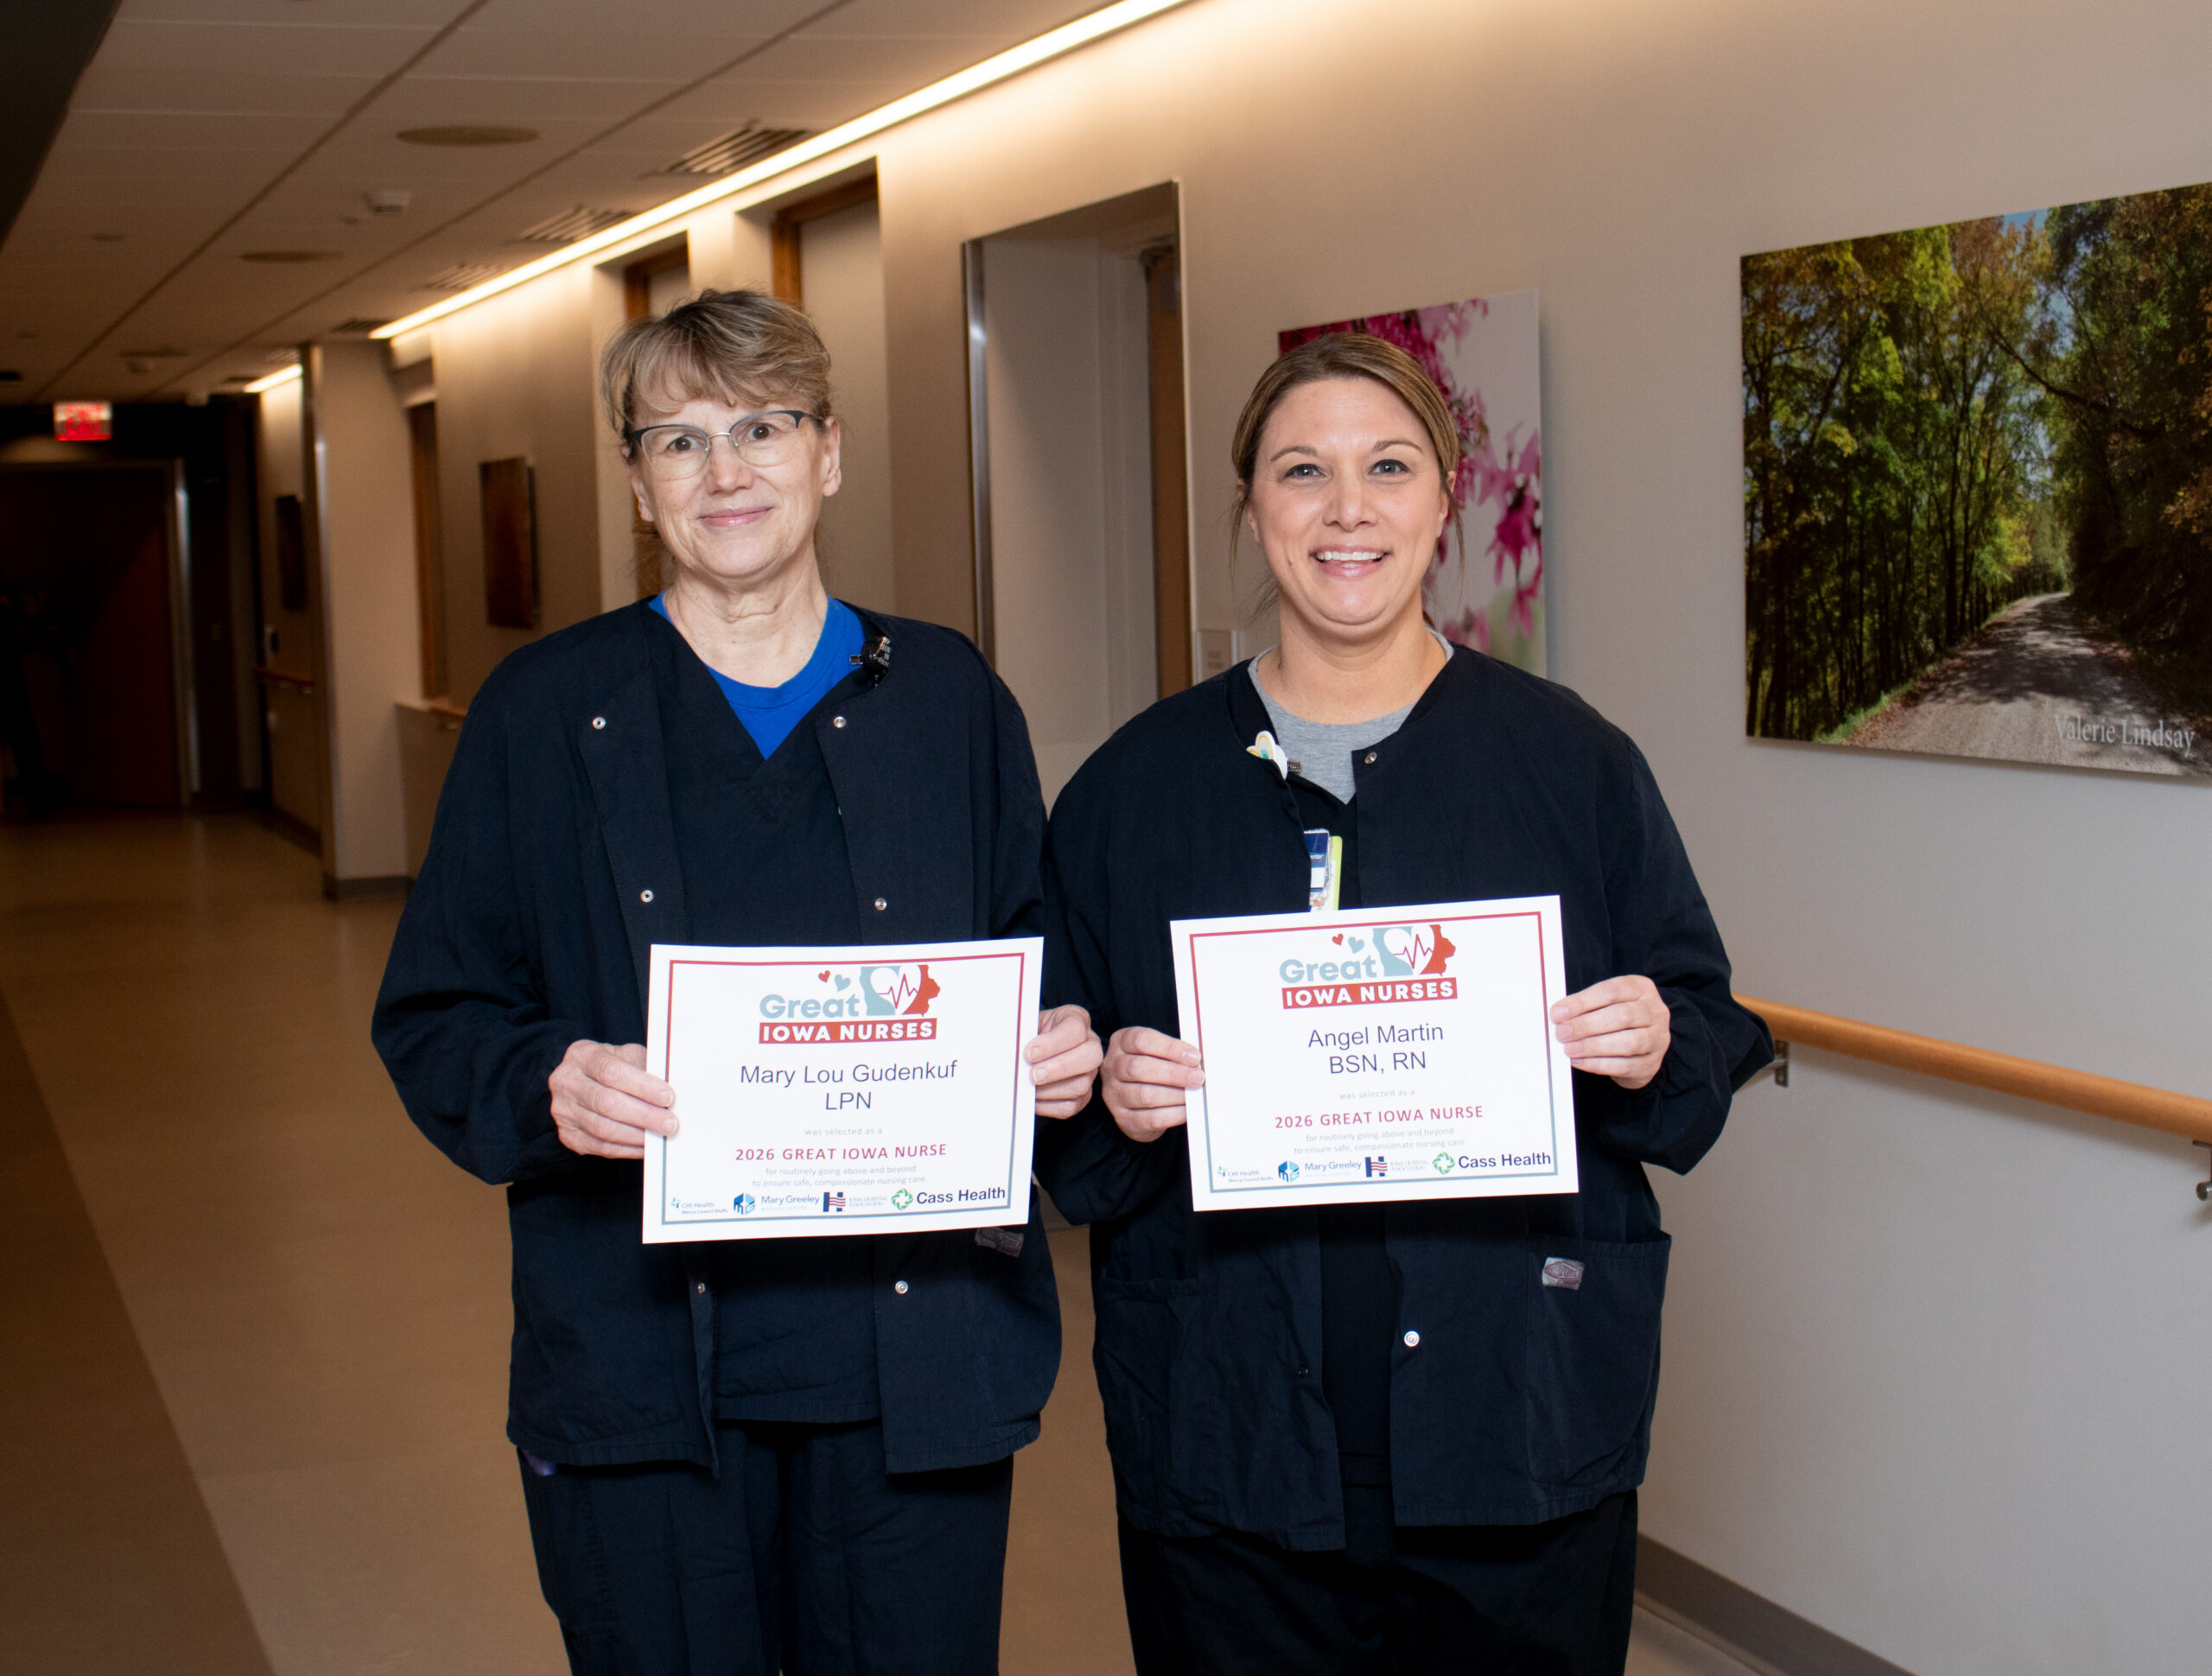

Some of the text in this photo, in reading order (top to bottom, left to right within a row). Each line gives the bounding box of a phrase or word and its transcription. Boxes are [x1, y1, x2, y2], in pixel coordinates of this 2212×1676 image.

[2055, 714, 2196, 758] Valerie Lindsay
[1280, 955, 1377, 981] Great
[1287, 981, 1453, 1006] IOWA NURSES
[760, 994, 860, 1019] Great
[764, 1021, 932, 1042] IOWA NURSES
[1308, 1023, 1443, 1051] Angel Martin
[1330, 1051, 1426, 1074] BSN, RN
[741, 1060, 957, 1088] Mary Lou Gudenkuf
[826, 1092, 871, 1109] LPN
[1275, 1106, 1483, 1128] 2026 GREAT IOWA NURSE
[1319, 1133, 1355, 1141] routinely
[1424, 1127, 1454, 1136] beyond
[736, 1144, 947, 1160] 2026 GREAT IOWA NURSE
[1334, 1144, 1352, 1152] safe,
[1355, 1142, 1414, 1152] compassionate
[1416, 1140, 1445, 1148] nursing
[1305, 1163, 1326, 1171] Mary
[1459, 1152, 1551, 1168] Cass Health
[779, 1168, 816, 1177] routinely
[887, 1165, 916, 1174] beyond
[786, 1196, 819, 1204] Greeley
[917, 1187, 1005, 1204] Cass Health
